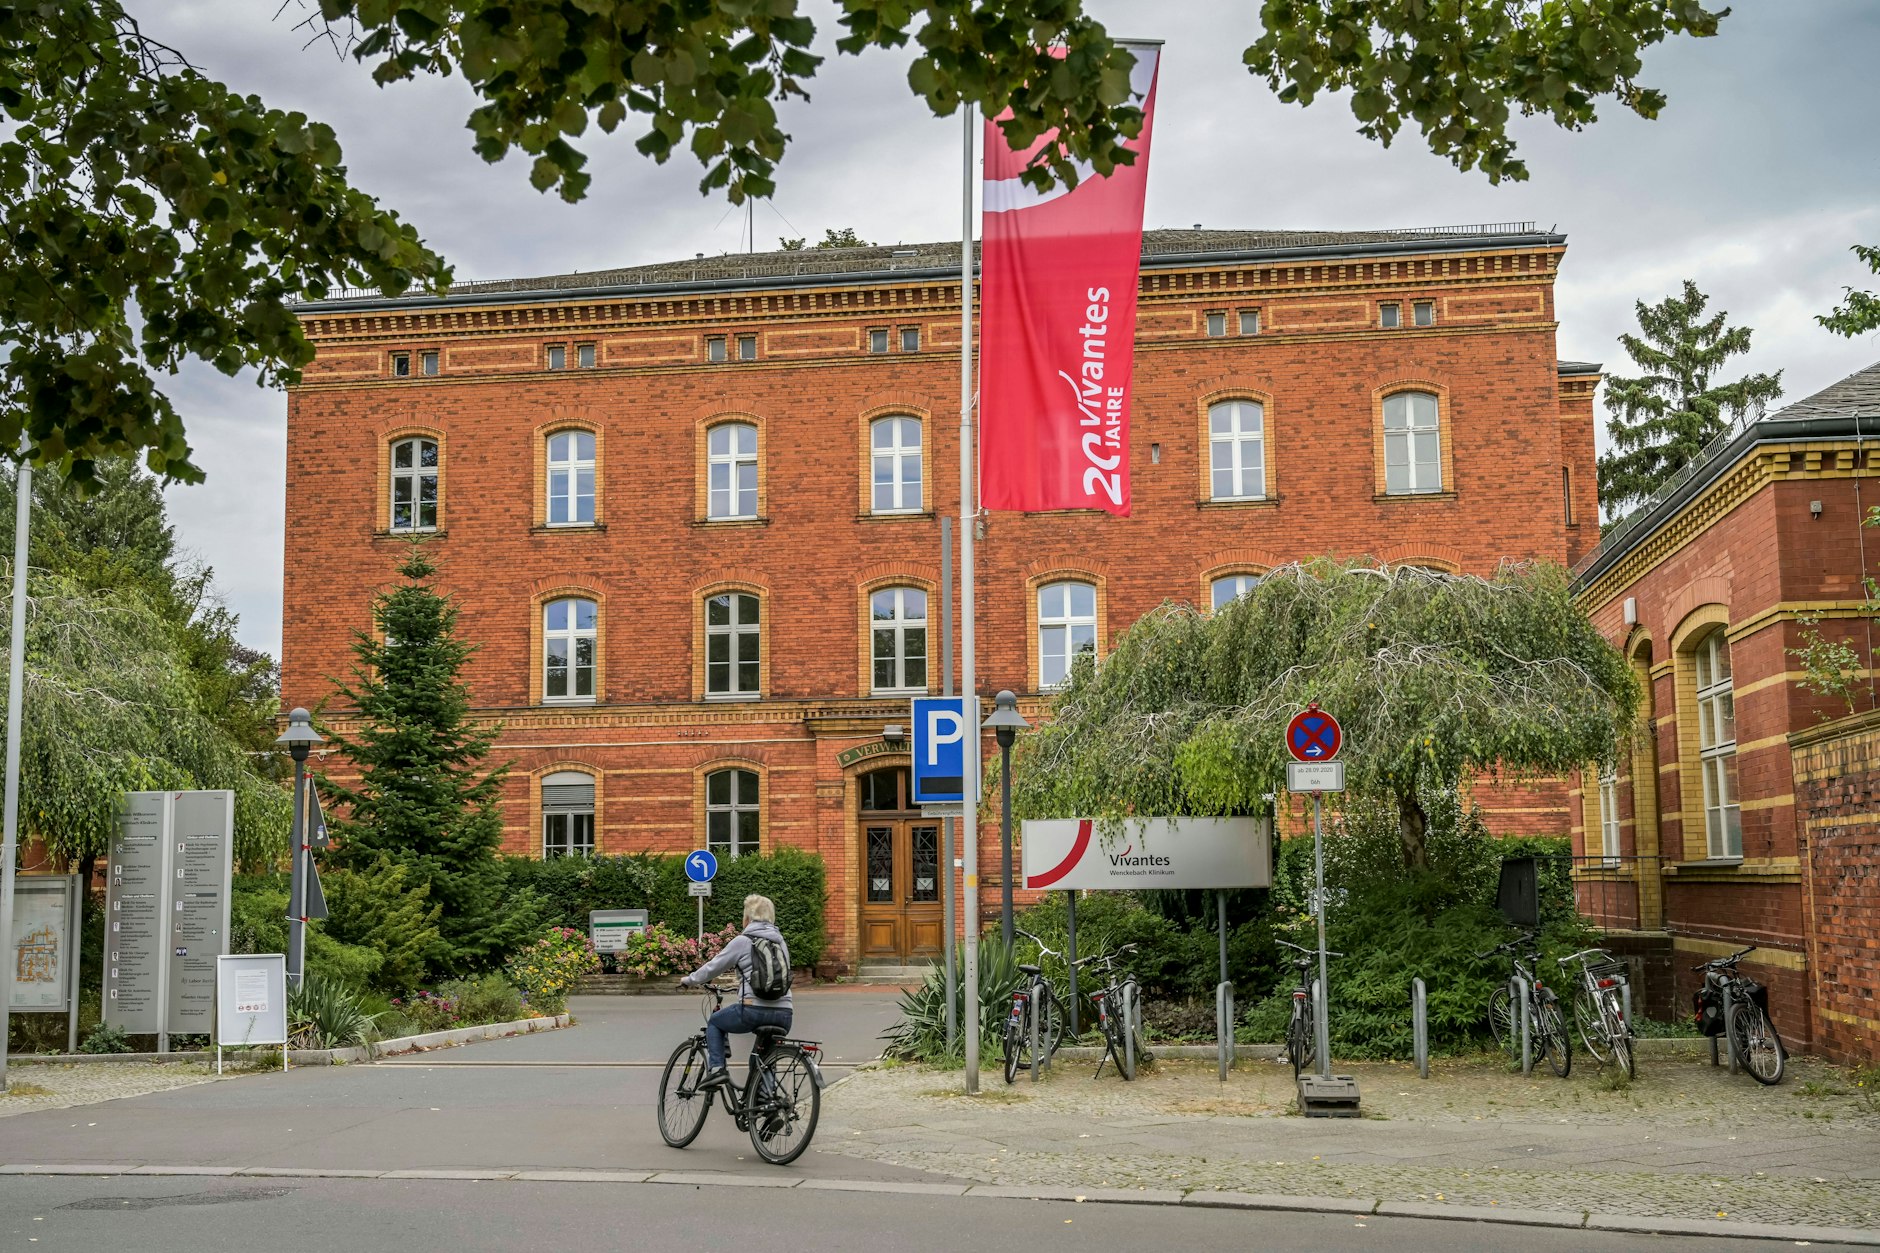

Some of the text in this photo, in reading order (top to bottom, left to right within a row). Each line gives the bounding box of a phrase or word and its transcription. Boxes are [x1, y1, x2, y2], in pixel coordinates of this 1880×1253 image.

[1076, 287, 1123, 505] 20 Vivantes
[1105, 386, 1124, 449] JAHRE
[927, 710, 963, 766] P
[1109, 853, 1170, 867] Vivantes
